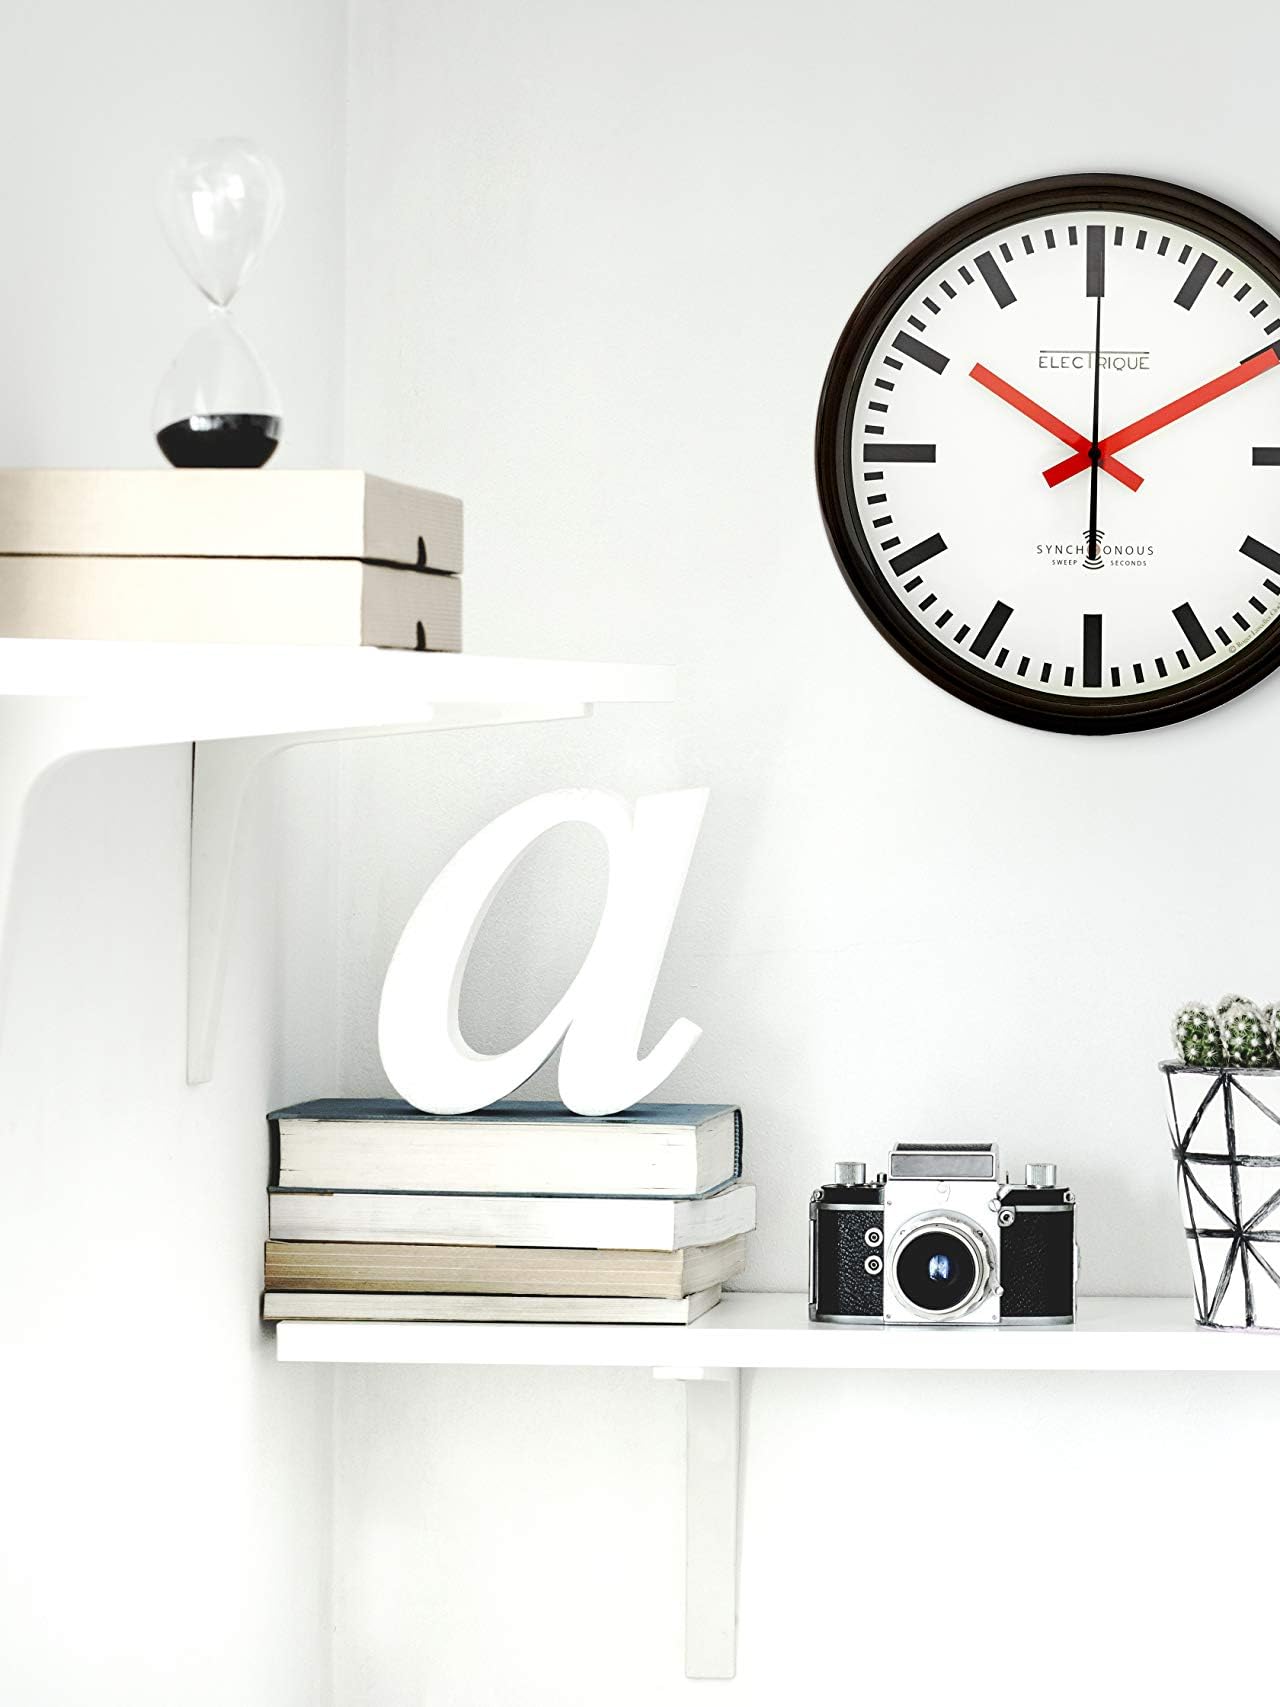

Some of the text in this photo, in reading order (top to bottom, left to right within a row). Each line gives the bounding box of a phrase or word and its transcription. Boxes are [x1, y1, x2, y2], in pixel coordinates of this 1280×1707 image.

[1038, 350, 1150, 371] ELECTRIQUE
[1036, 544, 1154, 556] SYNCHONOUS
[377, 787, 710, 1117] a
